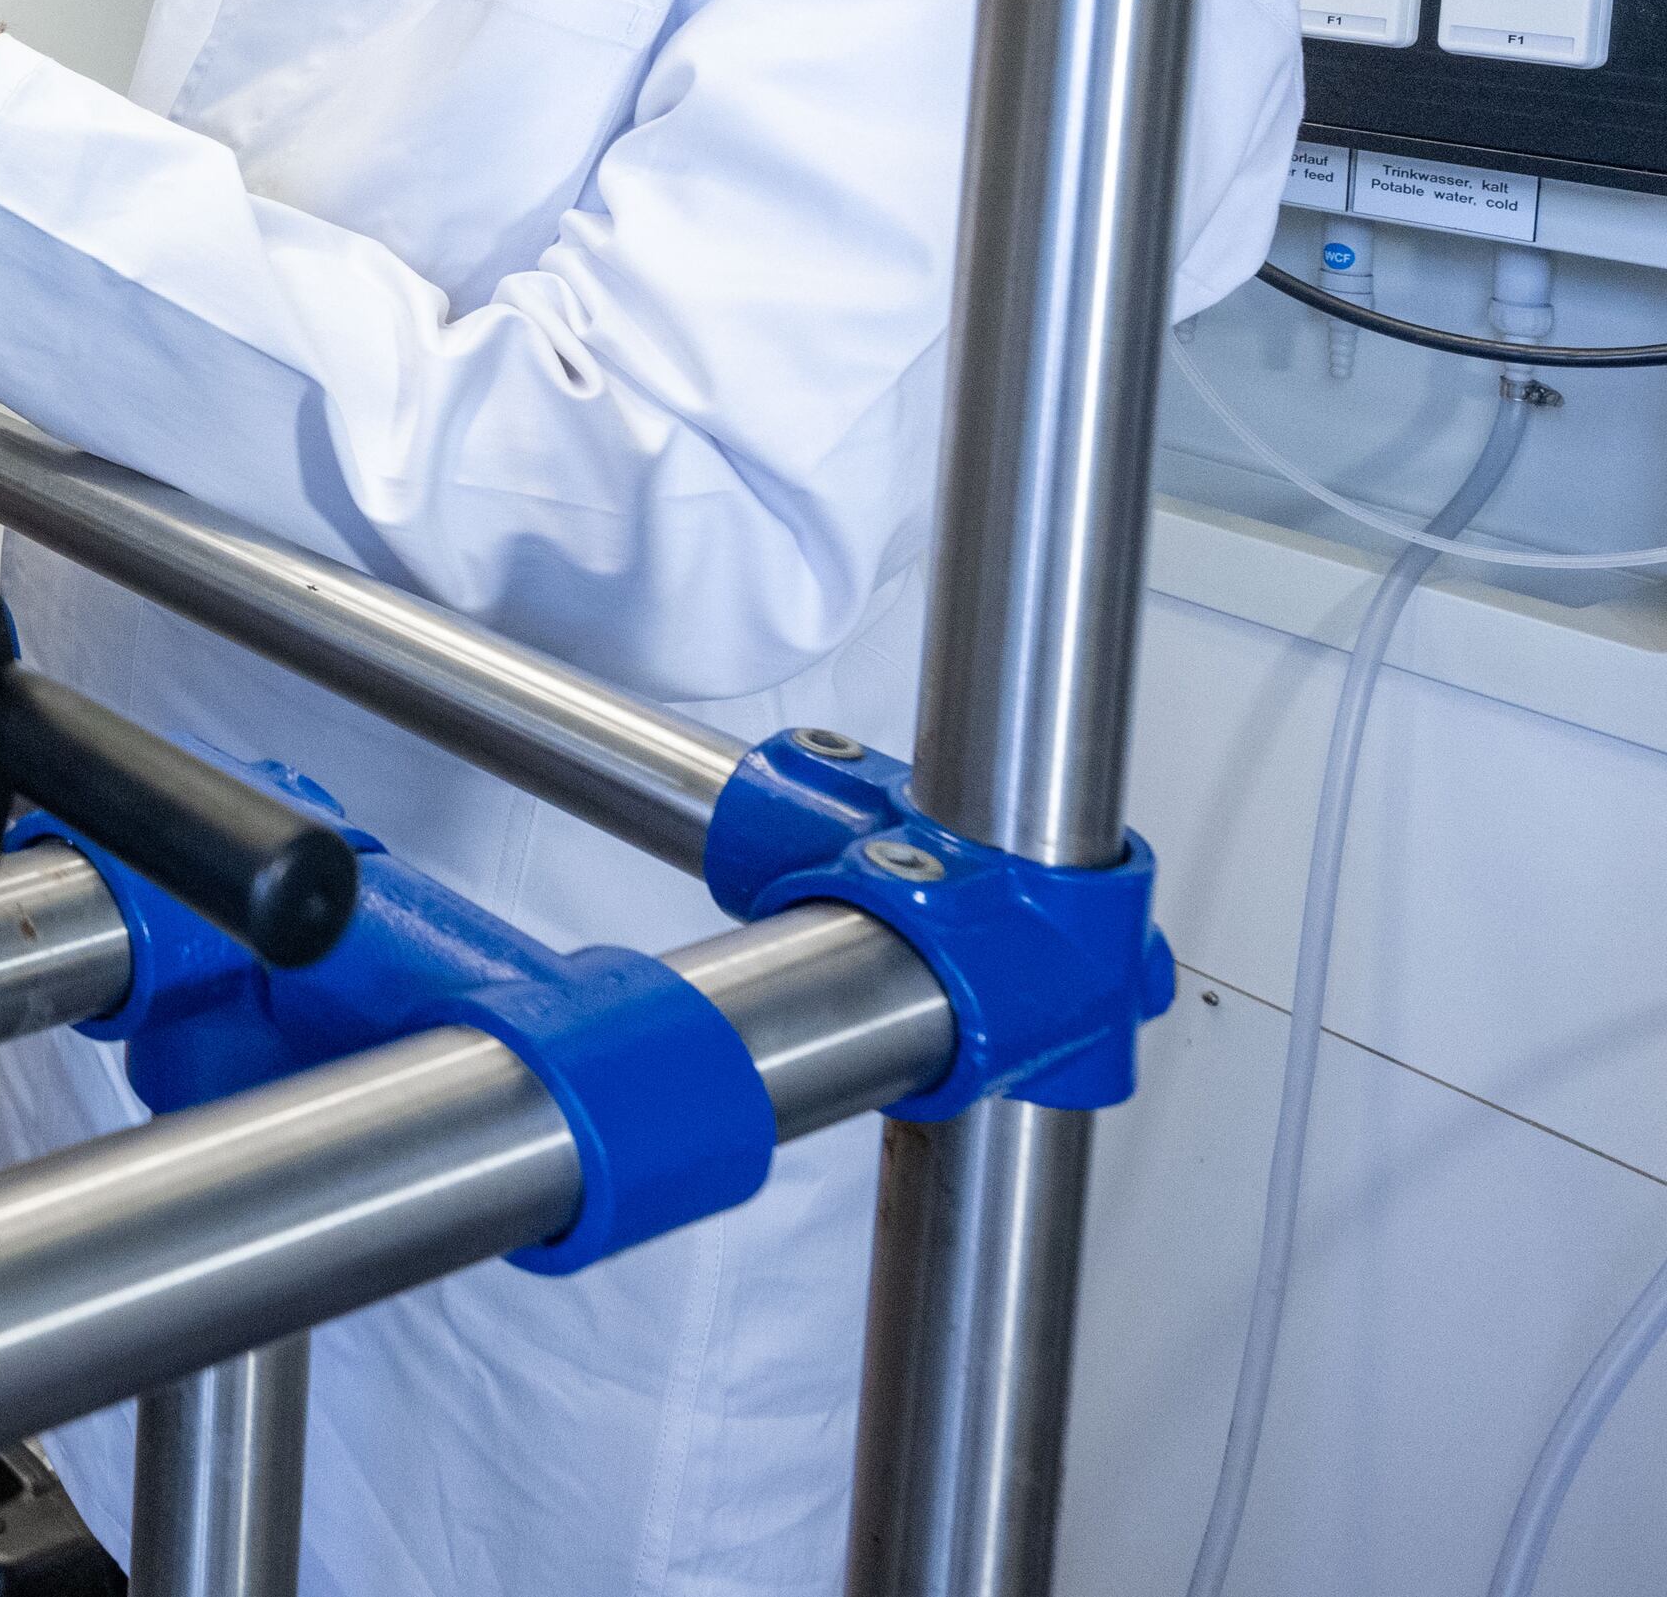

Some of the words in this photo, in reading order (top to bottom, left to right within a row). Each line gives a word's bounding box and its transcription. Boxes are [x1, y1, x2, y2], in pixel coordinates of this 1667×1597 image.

[1327, 15, 1342, 26] F1
[1508, 34, 1525, 45] F1
[1304, 168, 1334, 183] feed
[1481, 179, 1509, 194] kalt
[1371, 178, 1425, 197] Potable
[1485, 198, 1518, 212] cold
[1324, 251, 1351, 264] WCF
